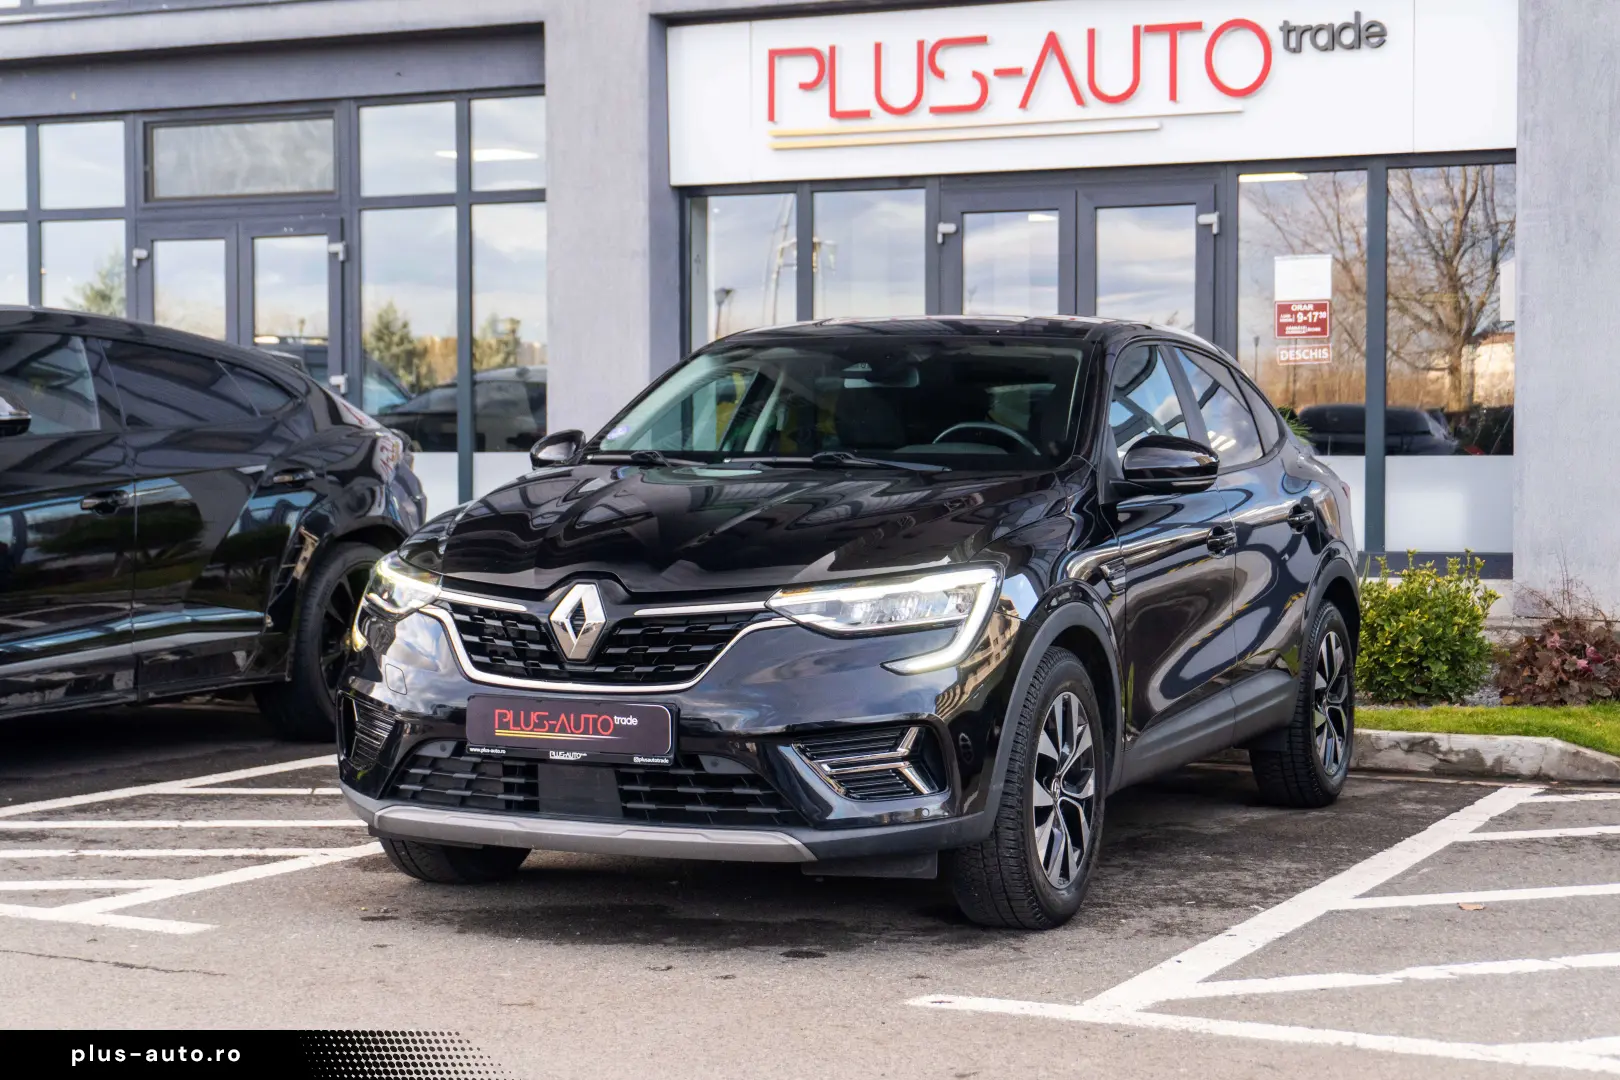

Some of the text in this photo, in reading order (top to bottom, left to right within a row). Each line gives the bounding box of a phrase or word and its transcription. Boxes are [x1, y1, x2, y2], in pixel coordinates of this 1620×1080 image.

[767, 11, 1388, 123] PLUS-AUTO trade
[1280, 348, 1329, 361] DESCHIS
[494, 709, 638, 736] PLUS-AUTO trade
